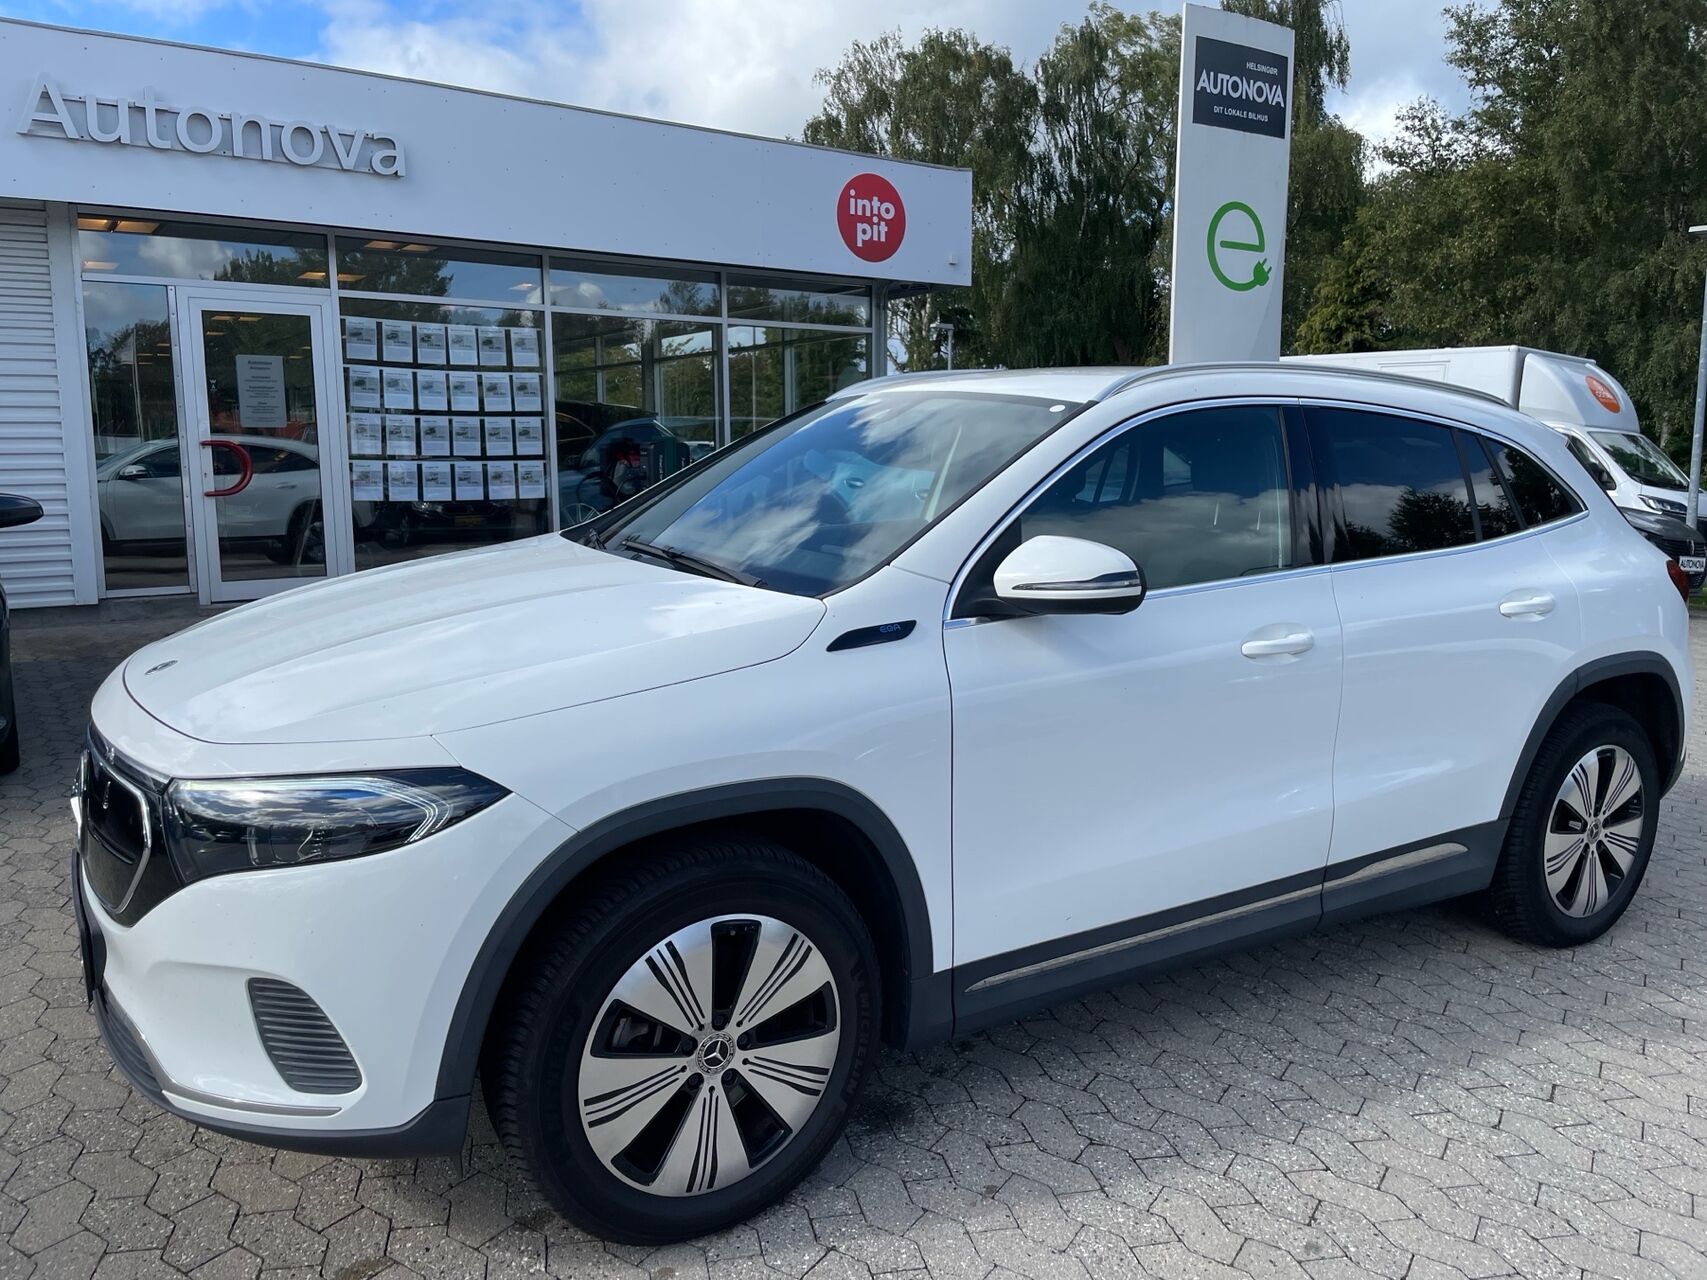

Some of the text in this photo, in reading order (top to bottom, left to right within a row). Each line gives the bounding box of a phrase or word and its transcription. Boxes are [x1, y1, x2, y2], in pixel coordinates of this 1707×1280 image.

[1196, 68, 1285, 108] AUTONOVA
[17, 72, 406, 177] Autonova
[1213, 105, 1269, 122] DIT LOKALE BILHUS
[849, 188, 896, 220] into
[856, 215, 888, 247] pit
[879, 623, 901, 633] EQA
[845, 992, 871, 1096] MICHELIN
